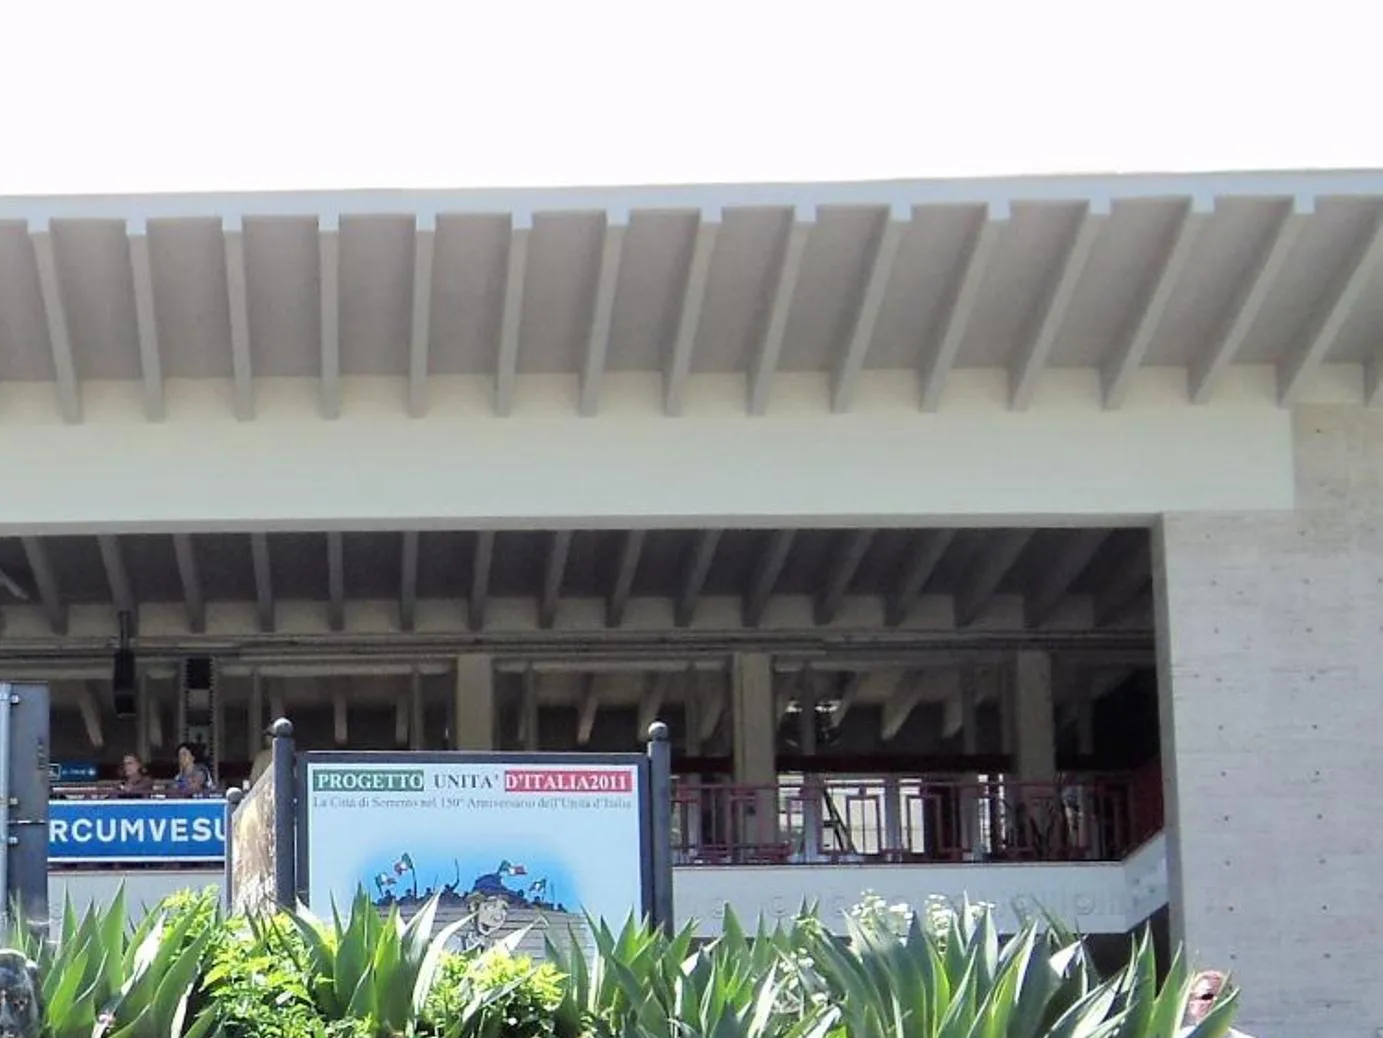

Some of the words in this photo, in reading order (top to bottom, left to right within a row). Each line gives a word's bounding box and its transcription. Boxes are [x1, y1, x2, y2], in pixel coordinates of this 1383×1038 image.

[317, 773, 424, 789] PROGETTO
[434, 774, 499, 789] UNITA'
[313, 796, 327, 809] La
[358, 796, 369, 809] di
[467, 797, 535, 809] Anniversario
